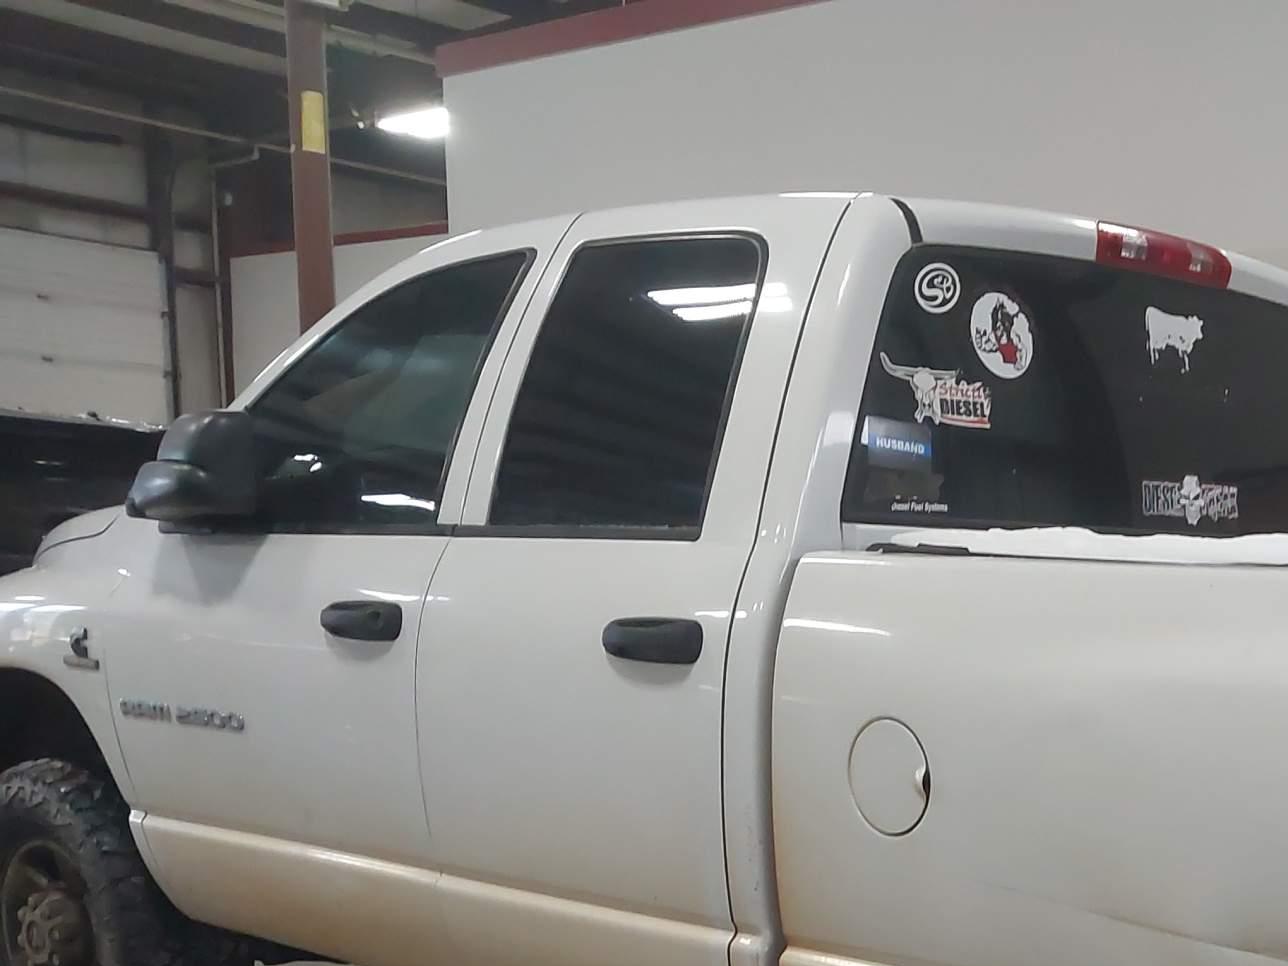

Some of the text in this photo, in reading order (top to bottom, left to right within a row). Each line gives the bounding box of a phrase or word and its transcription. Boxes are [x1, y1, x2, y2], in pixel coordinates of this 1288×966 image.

[940, 398, 987, 418] DIESEL
[875, 436, 926, 455] HUSBAND
[911, 501, 924, 512] Fuel
[924, 501, 948, 514] Systems
